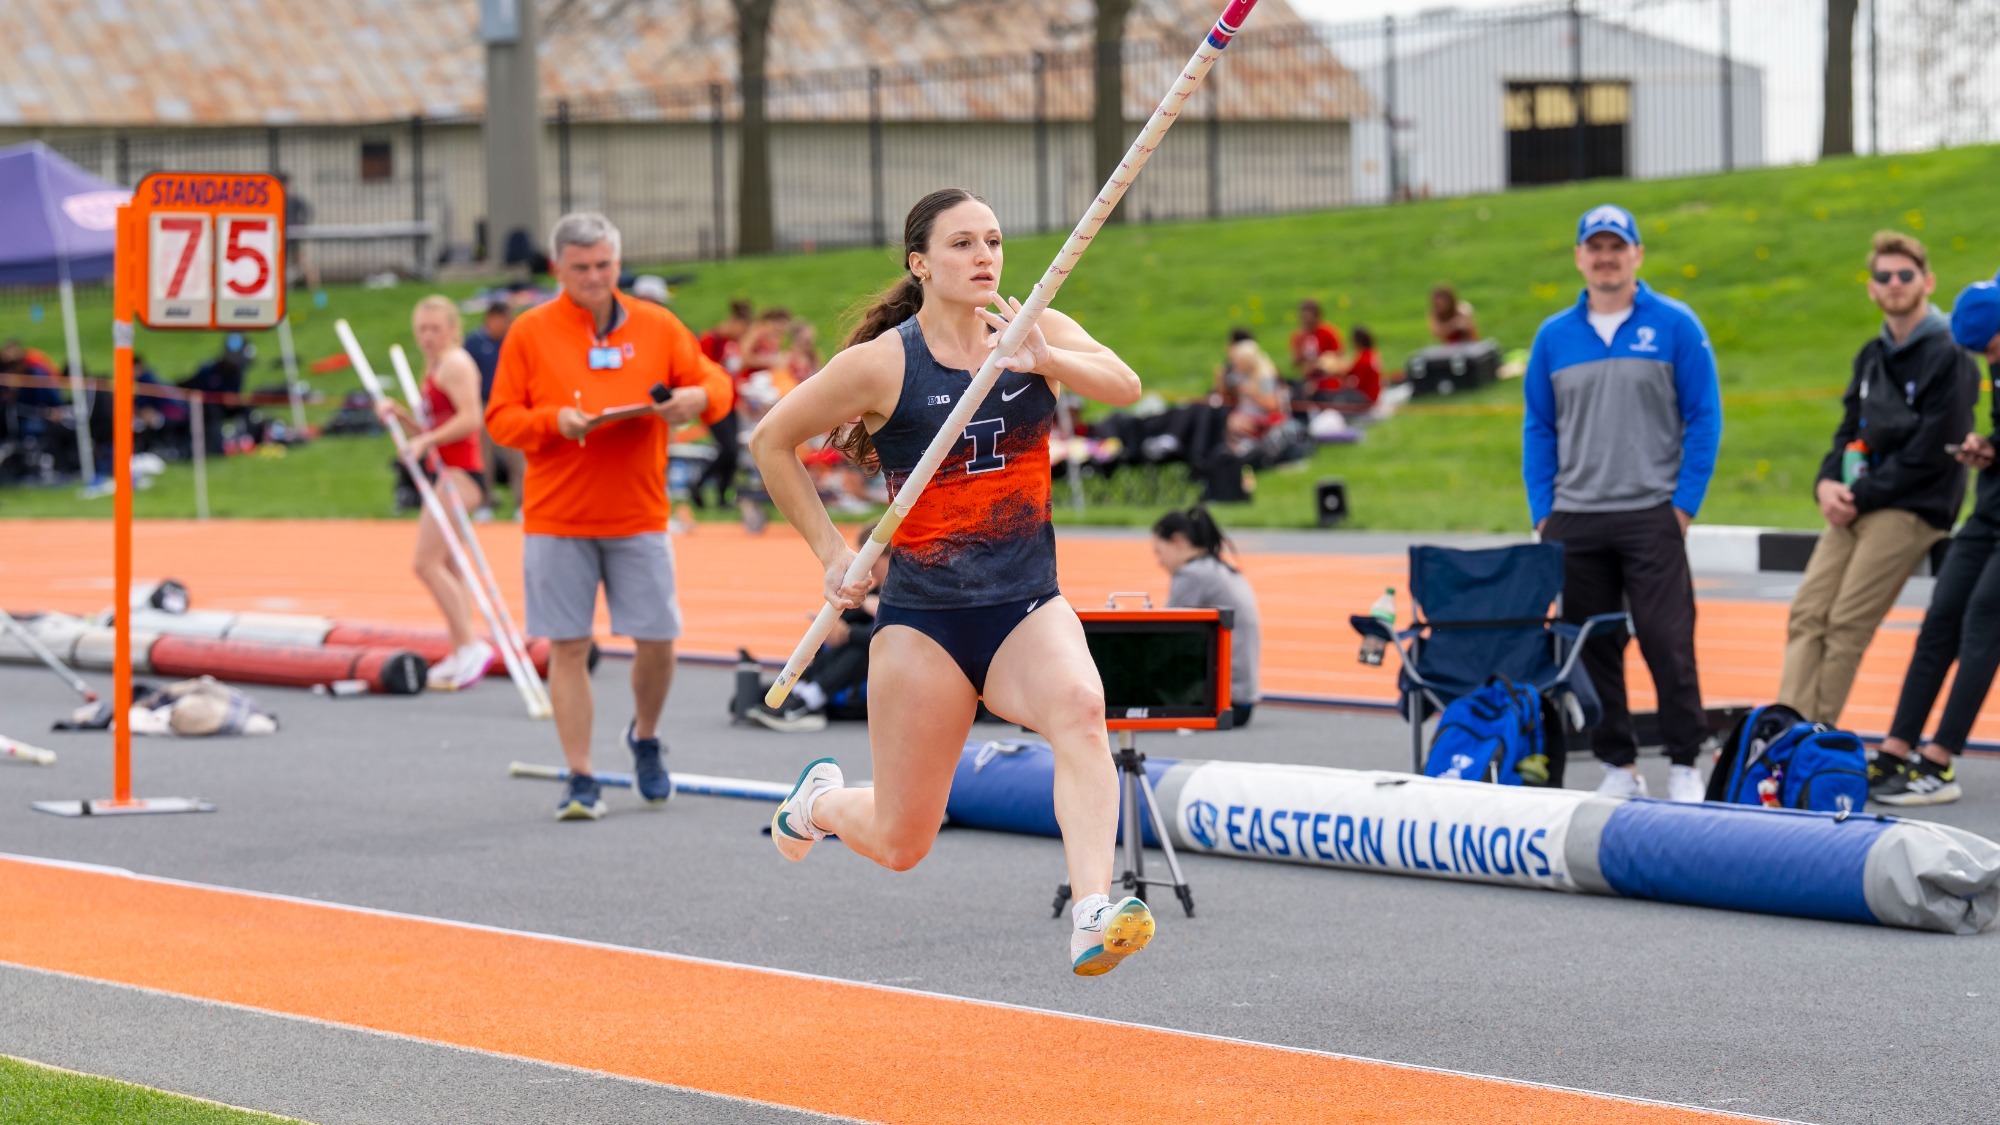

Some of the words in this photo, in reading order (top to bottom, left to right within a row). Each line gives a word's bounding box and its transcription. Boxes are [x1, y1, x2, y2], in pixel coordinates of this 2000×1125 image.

[152, 180, 269, 206] STANDARDS
[963, 417, 1005, 474] I
[1227, 805, 1387, 866] EASTERN
[1398, 819, 1551, 877] ILLINOIS
